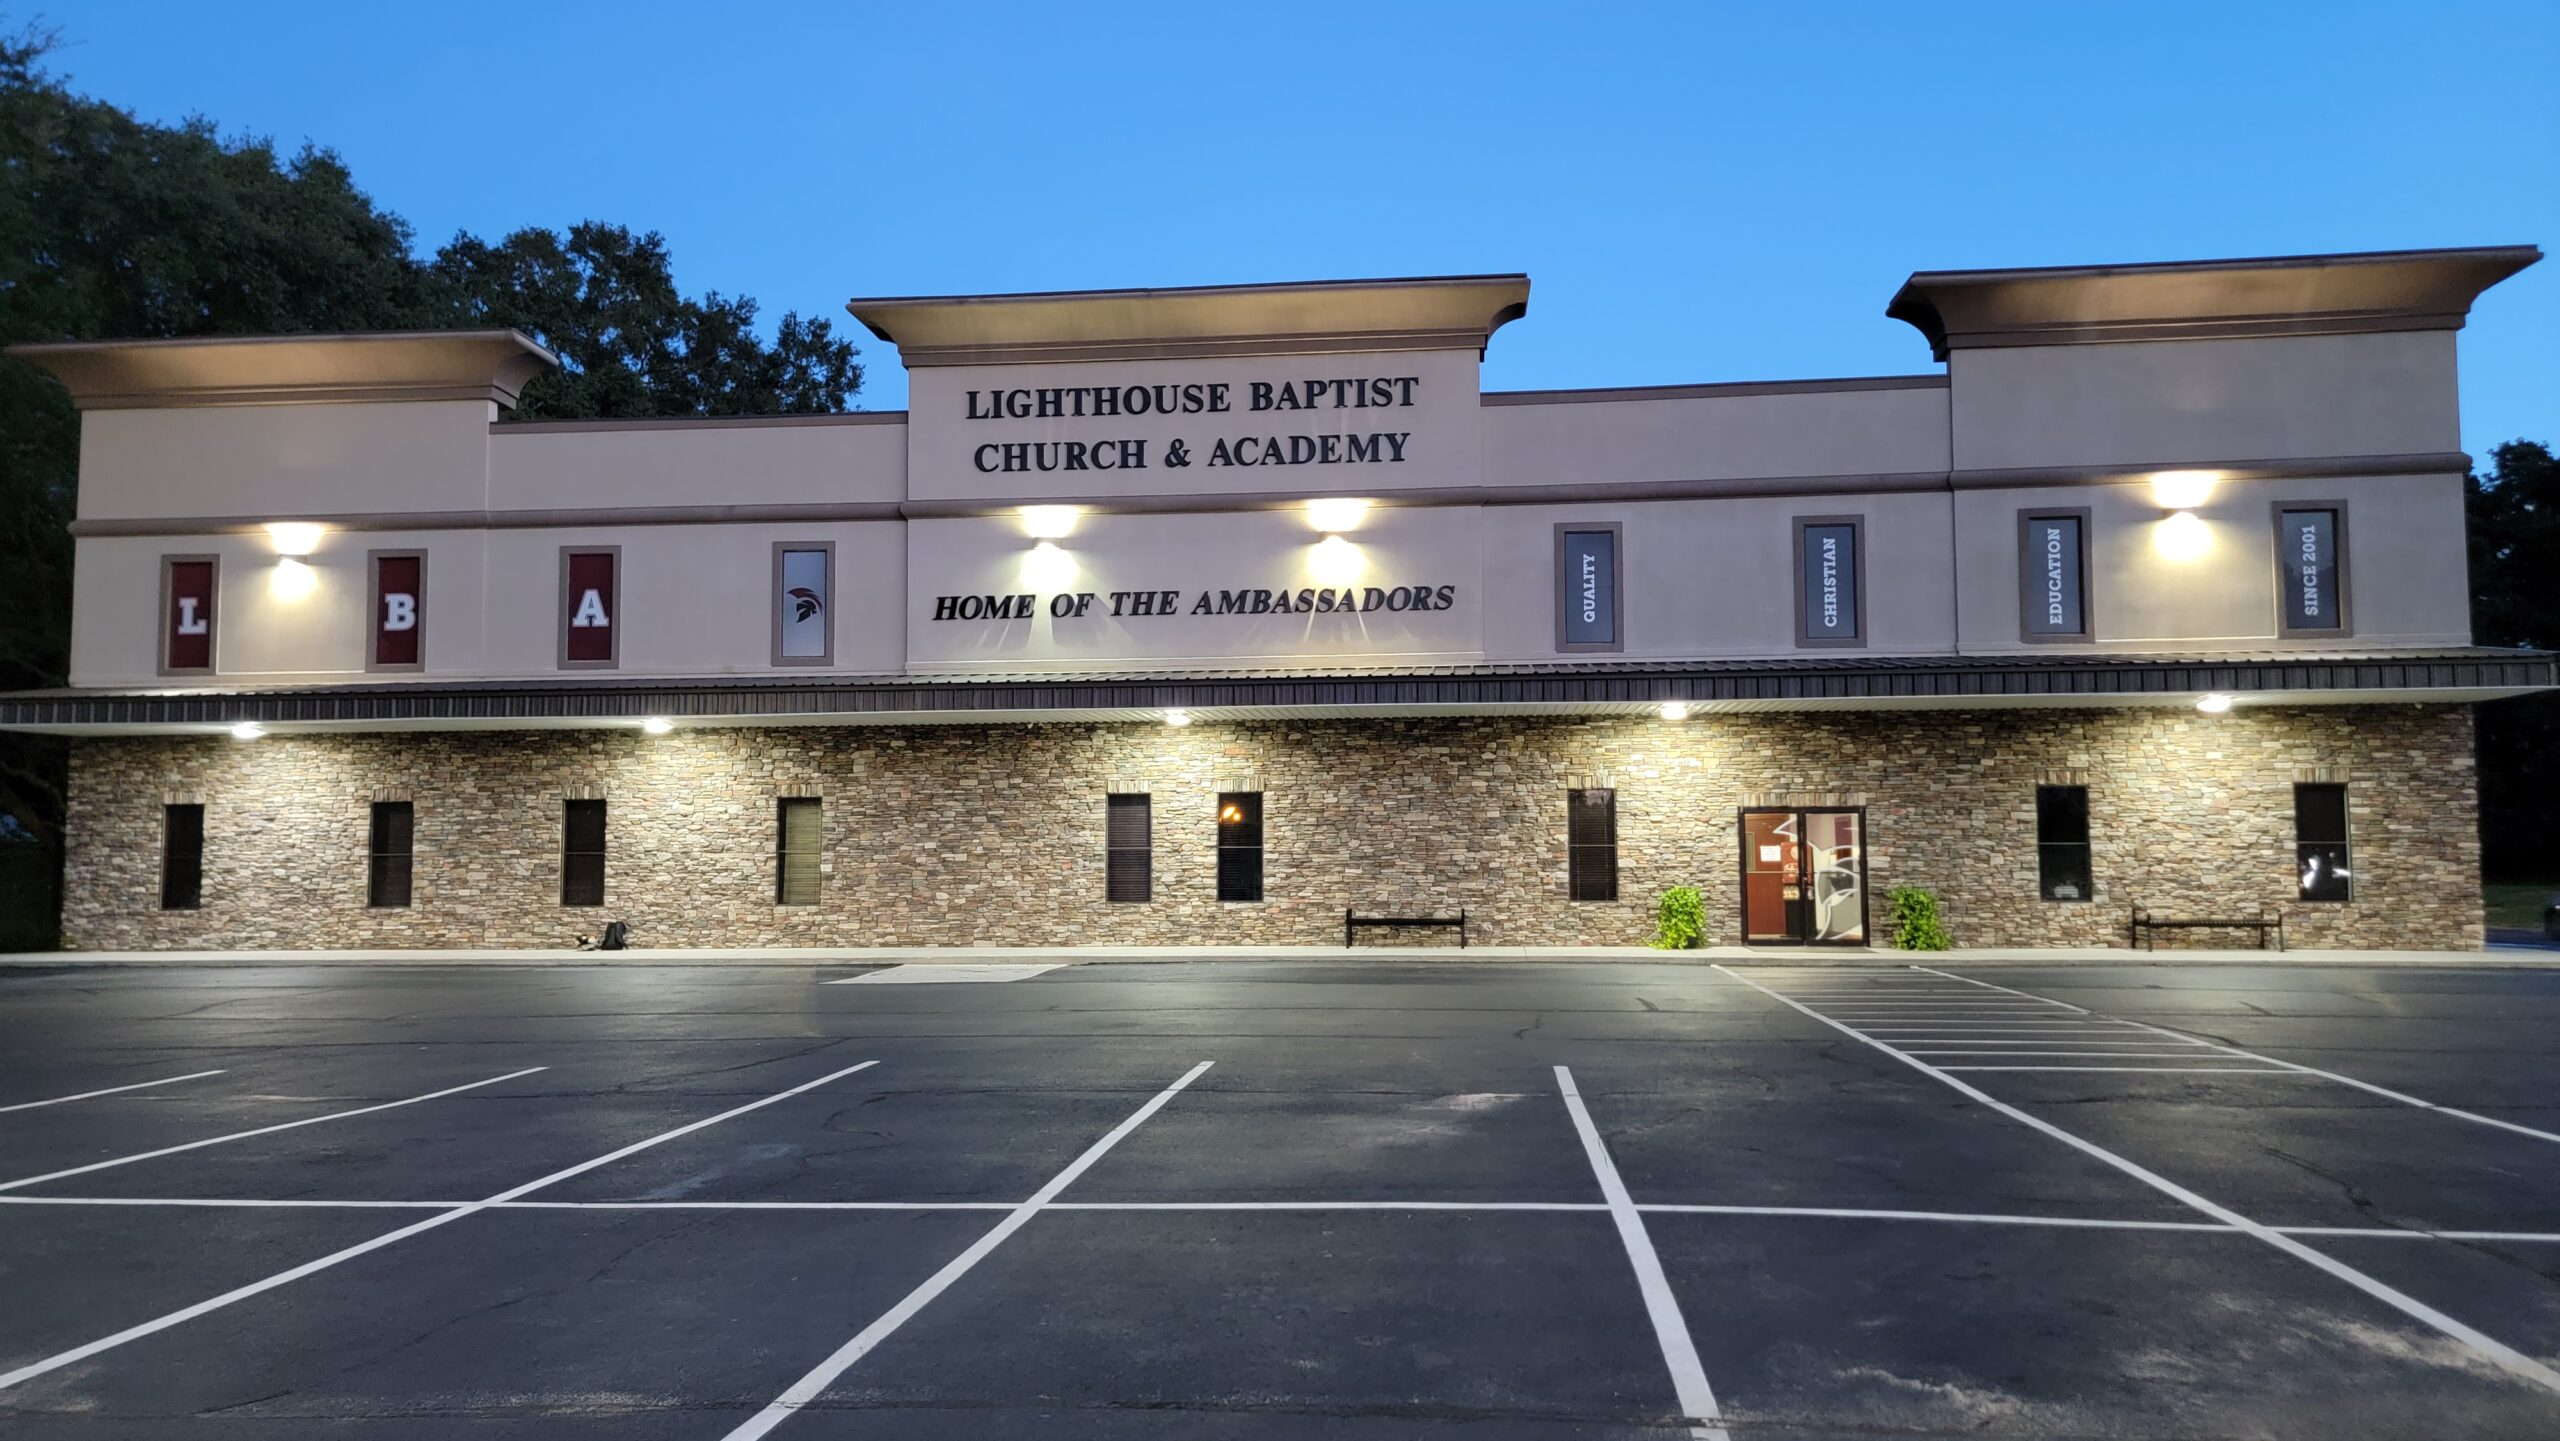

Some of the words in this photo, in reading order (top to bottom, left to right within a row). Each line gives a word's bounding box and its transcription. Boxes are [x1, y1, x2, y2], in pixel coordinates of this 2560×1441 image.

[966, 383, 1231, 420] LIGHTHOUSE
[1250, 376, 1419, 411] BAPTIST
[974, 439, 1147, 472] CHURCH
[1165, 438, 1191, 468] &
[1208, 432, 1410, 467] ACADEMY
[2302, 525, 2316, 562] 2001
[1582, 553, 1596, 622] QUALITY
[1823, 537, 1839, 627] CHRISTIAN
[2047, 527, 2064, 625] EDUCATION
[2303, 565, 2318, 616] SINCE
[178, 597, 208, 636] L
[384, 593, 415, 632] B
[572, 588, 610, 628] A
[933, 594, 1035, 621] HOME
[1050, 592, 1095, 617] OF
[1110, 590, 1179, 617] THE
[1191, 584, 1455, 615] AMBASSADORS
